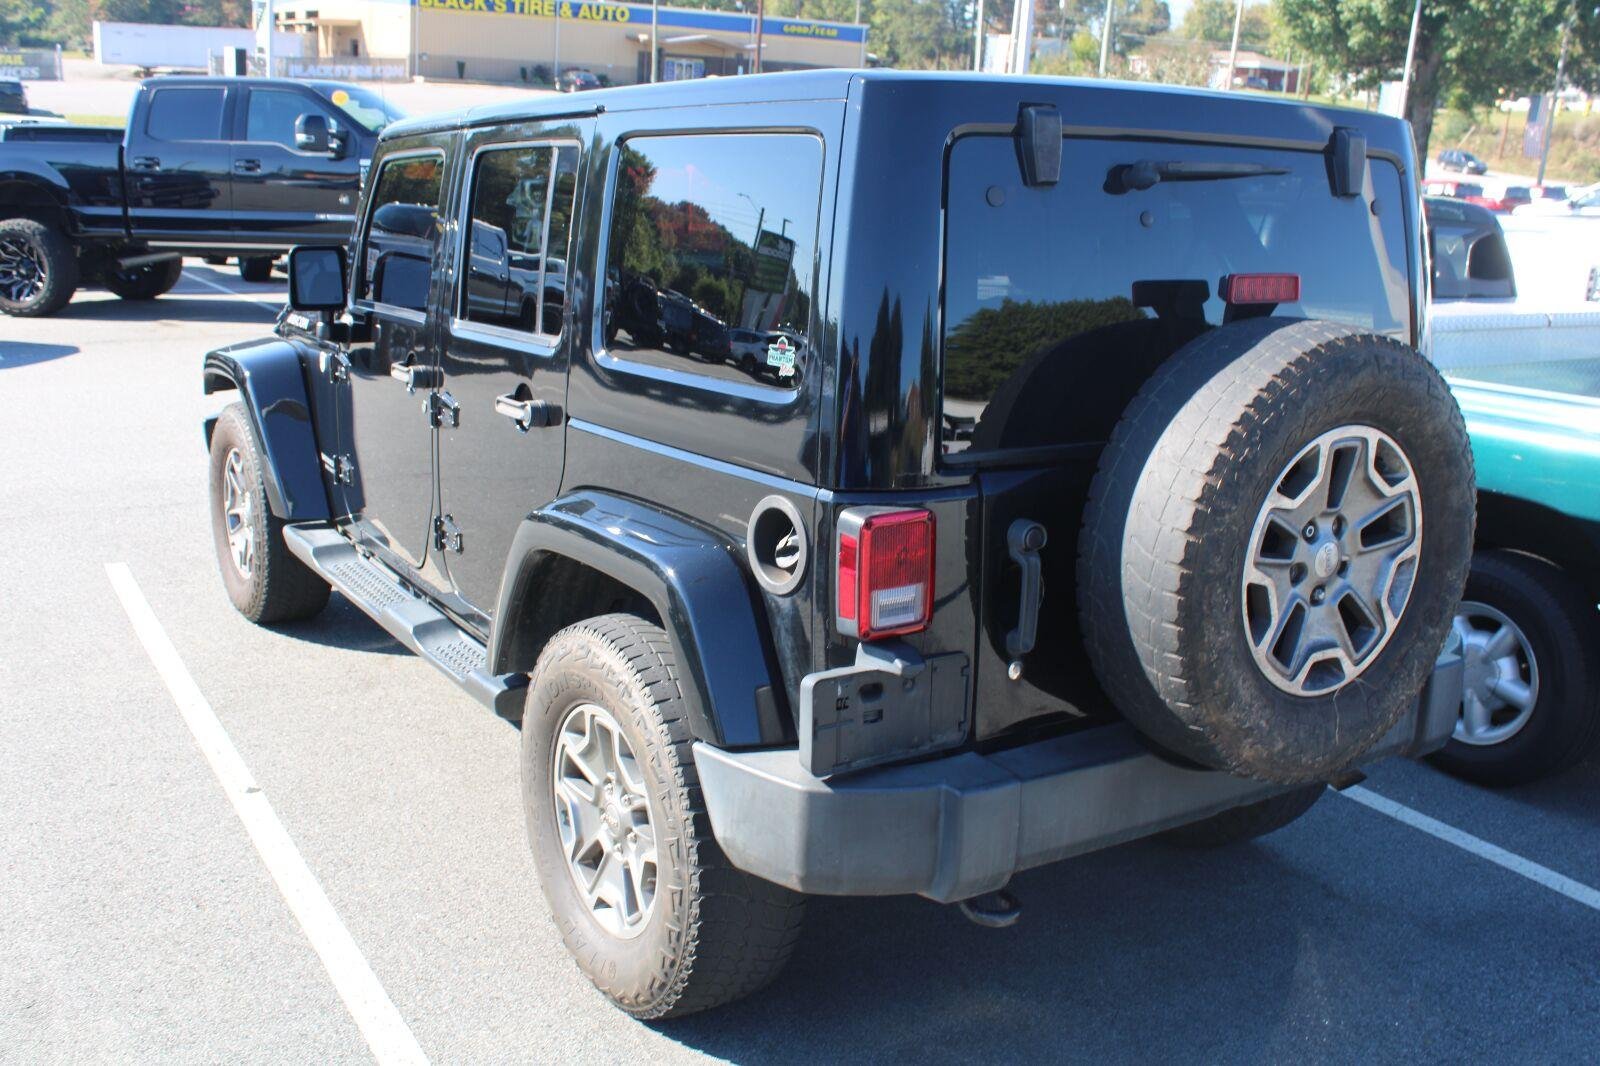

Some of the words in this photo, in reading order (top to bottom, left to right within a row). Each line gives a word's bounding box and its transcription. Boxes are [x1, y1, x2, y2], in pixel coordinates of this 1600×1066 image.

[511, 0, 556, 17] TIRE
[560, 3, 573, 18] &
[577, 4, 631, 23] AUTO
